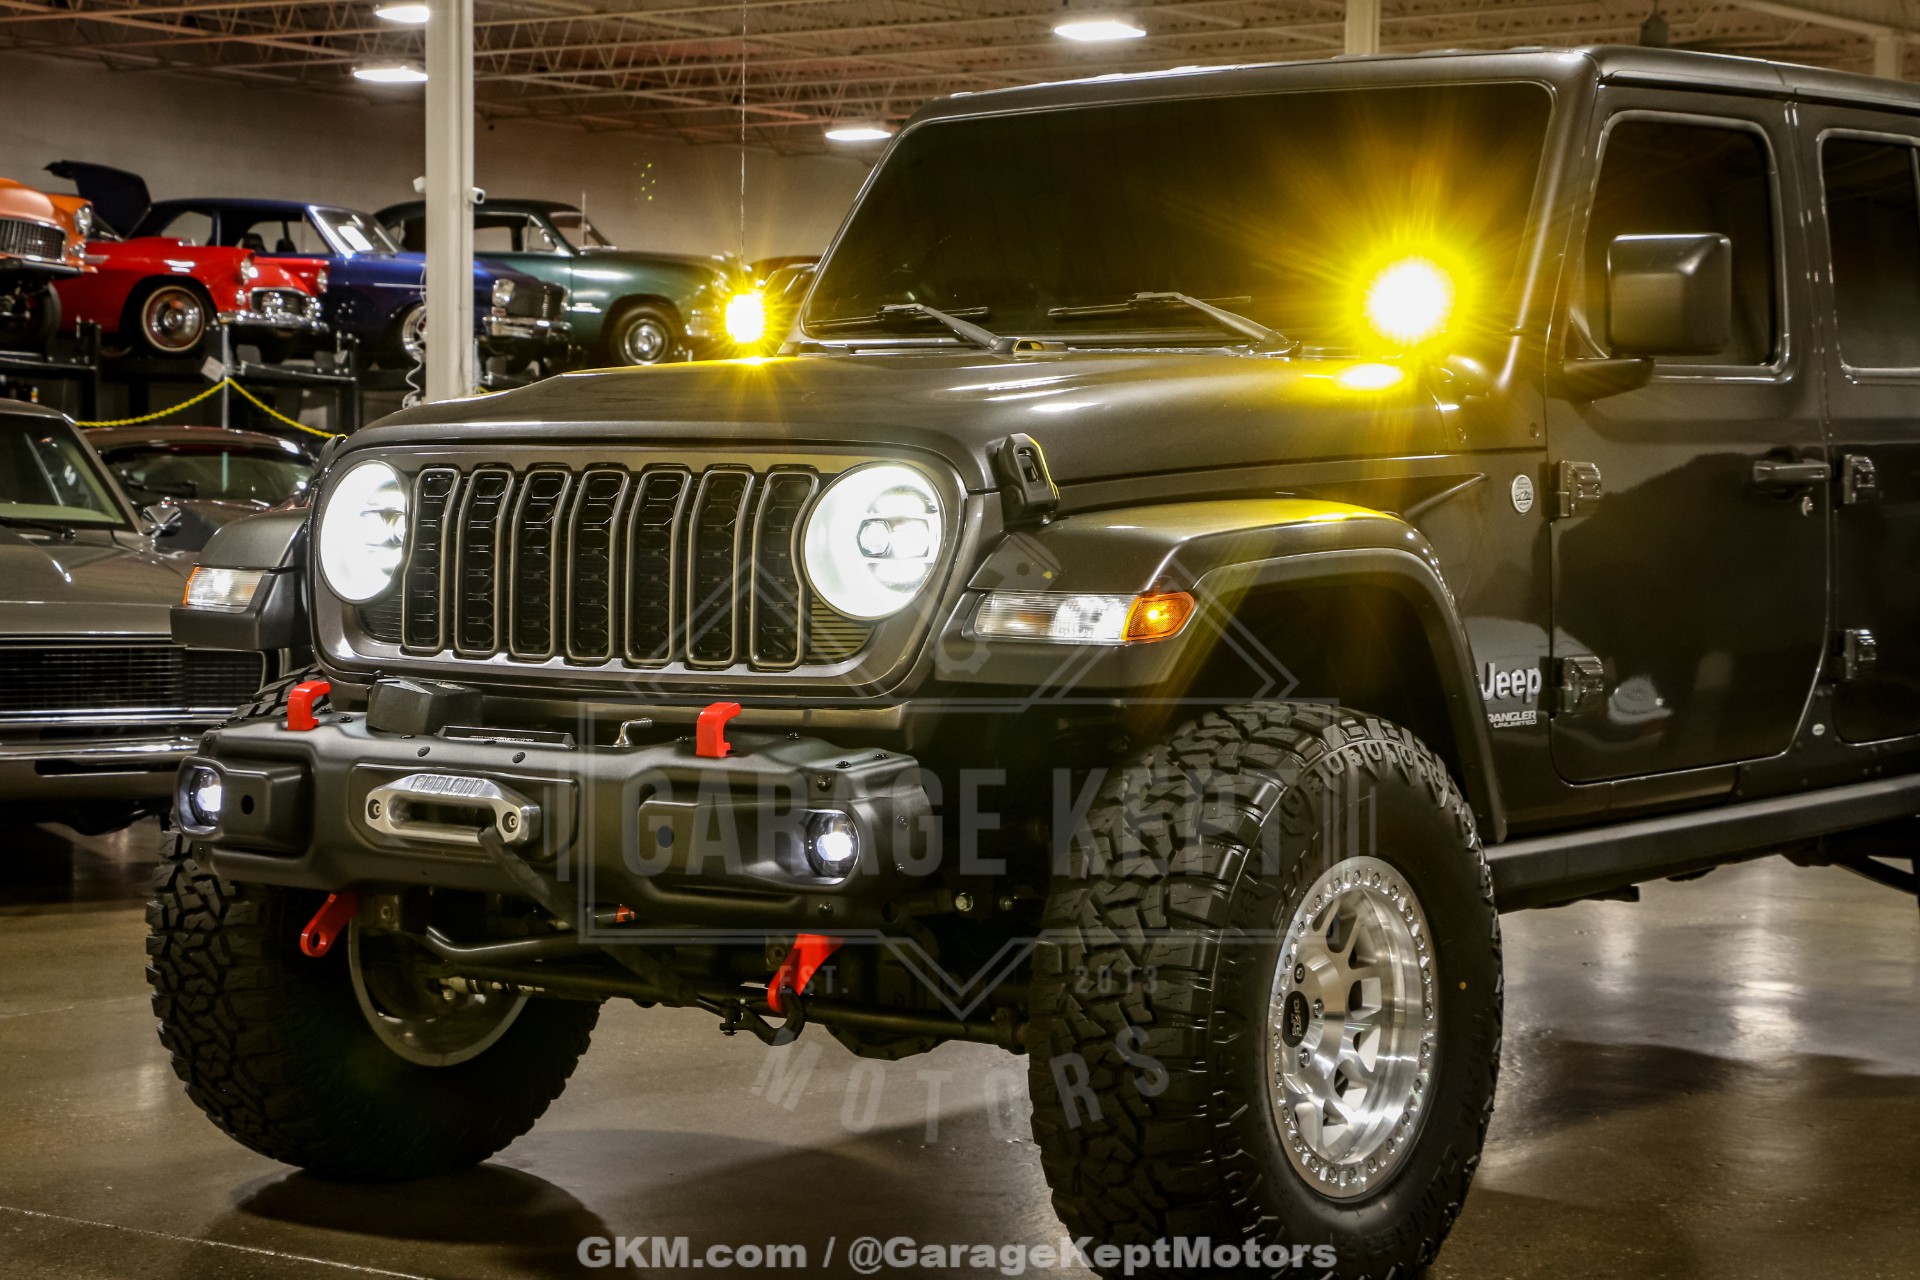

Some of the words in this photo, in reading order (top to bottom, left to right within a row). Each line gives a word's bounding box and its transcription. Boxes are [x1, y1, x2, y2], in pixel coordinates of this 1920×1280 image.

[1480, 662, 1542, 704] Jeep
[1487, 710, 1537, 723] RANGLER
[1493, 719, 1537, 728] UNLIMITED
